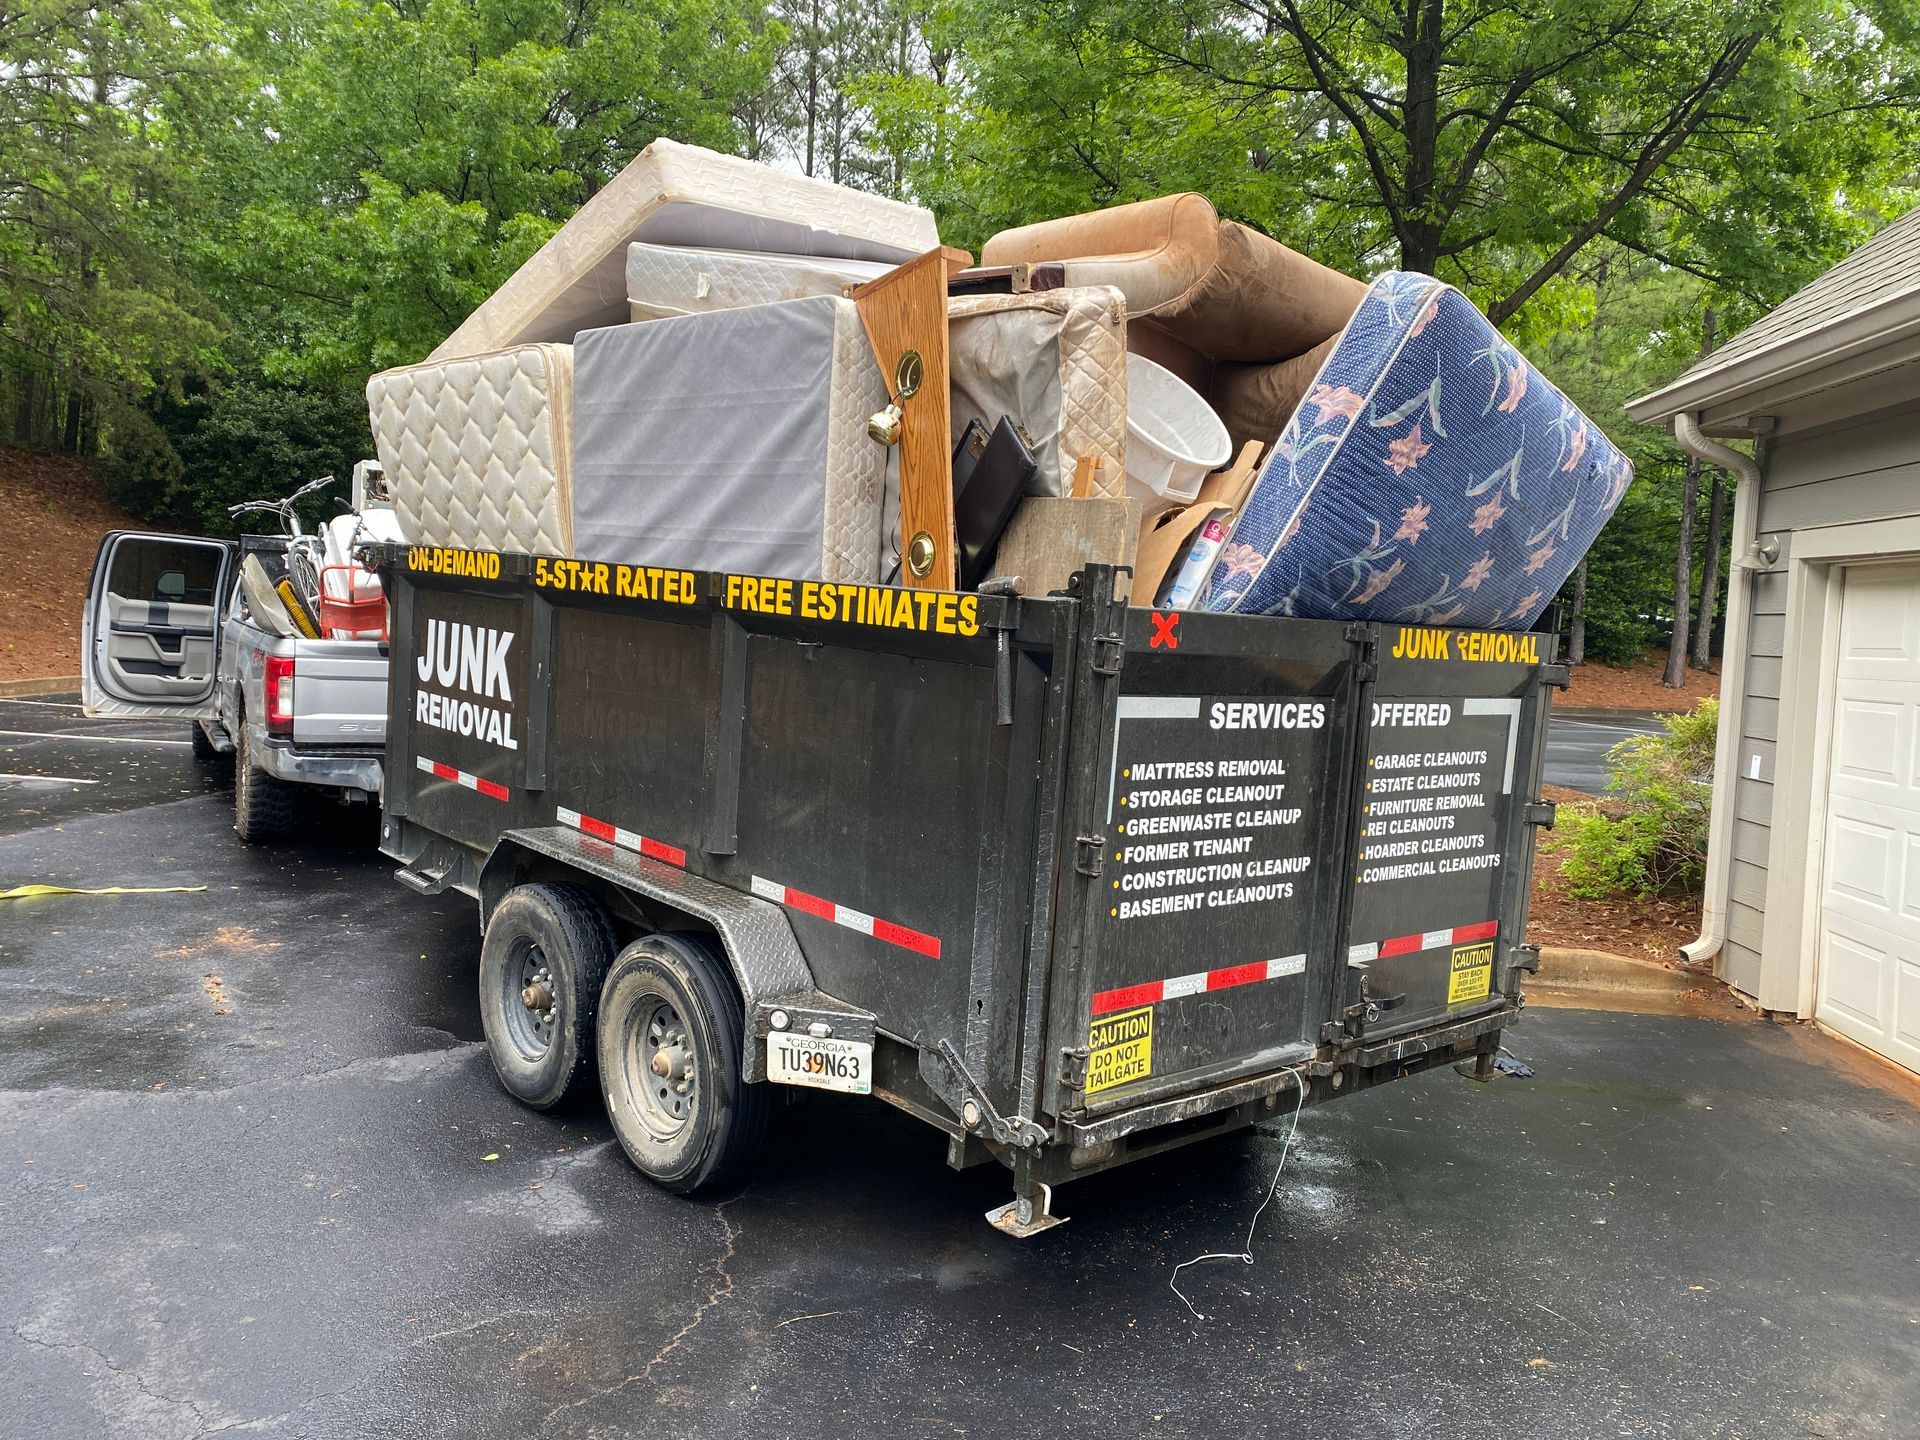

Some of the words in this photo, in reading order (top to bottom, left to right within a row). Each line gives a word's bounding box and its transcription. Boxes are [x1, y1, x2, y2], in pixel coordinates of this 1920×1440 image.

[408, 547, 500, 580] ON-DEMAND
[616, 565, 697, 605] RATED
[727, 575, 793, 616] FREE
[800, 582, 980, 637] ESTIMATES
[417, 618, 515, 702] JUNK
[1393, 628, 1451, 660] JUNK
[1457, 632, 1540, 664] REMOVAL
[416, 689, 518, 750] REMOVAL
[1209, 702, 1326, 730] SERVICES
[1131, 761, 1214, 781] MATTRESS
[1218, 759, 1286, 777] REMOVAL
[1374, 754, 1421, 770] GARAGE
[1424, 750, 1487, 768] CLEANOUTS
[1129, 788, 1203, 809] STORAGE
[1206, 784, 1285, 804] CLEANOUT
[1371, 777, 1414, 793] ESTATE
[1417, 772, 1481, 791] CLEANOUTS
[1369, 797, 1433, 817] FURNITURE
[1436, 793, 1485, 811] REMOVAL
[1126, 813, 1232, 836] GREENWASTE
[1236, 808, 1302, 828] CLEANUP
[1367, 821, 1387, 837] REI
[1389, 815, 1455, 836] CLEANOUTS
[1124, 842, 1189, 864] FORMER
[1194, 837, 1253, 857] TENANT
[1365, 840, 1419, 861] HOARDER
[1421, 834, 1485, 854] CLEANOUTS
[1121, 862, 1242, 892] CONSTRUCTION
[1247, 857, 1311, 878] CLEANUP
[1363, 861, 1437, 884] COMMERCIAL
[1439, 853, 1501, 874] CLEANOUTS
[1119, 892, 1204, 919] BASEMENT
[1208, 882, 1294, 907] CLEANOUTS
[1454, 948, 1491, 969] CAUTION
[791, 1038, 847, 1054] GEORGIA
[1089, 1014, 1148, 1050] CAUTION
[778, 1046, 860, 1079] TU39N63
[1095, 1051, 1113, 1070] DO
[1116, 1043, 1140, 1064] NOT
[1089, 1058, 1145, 1089] TAILGATE
